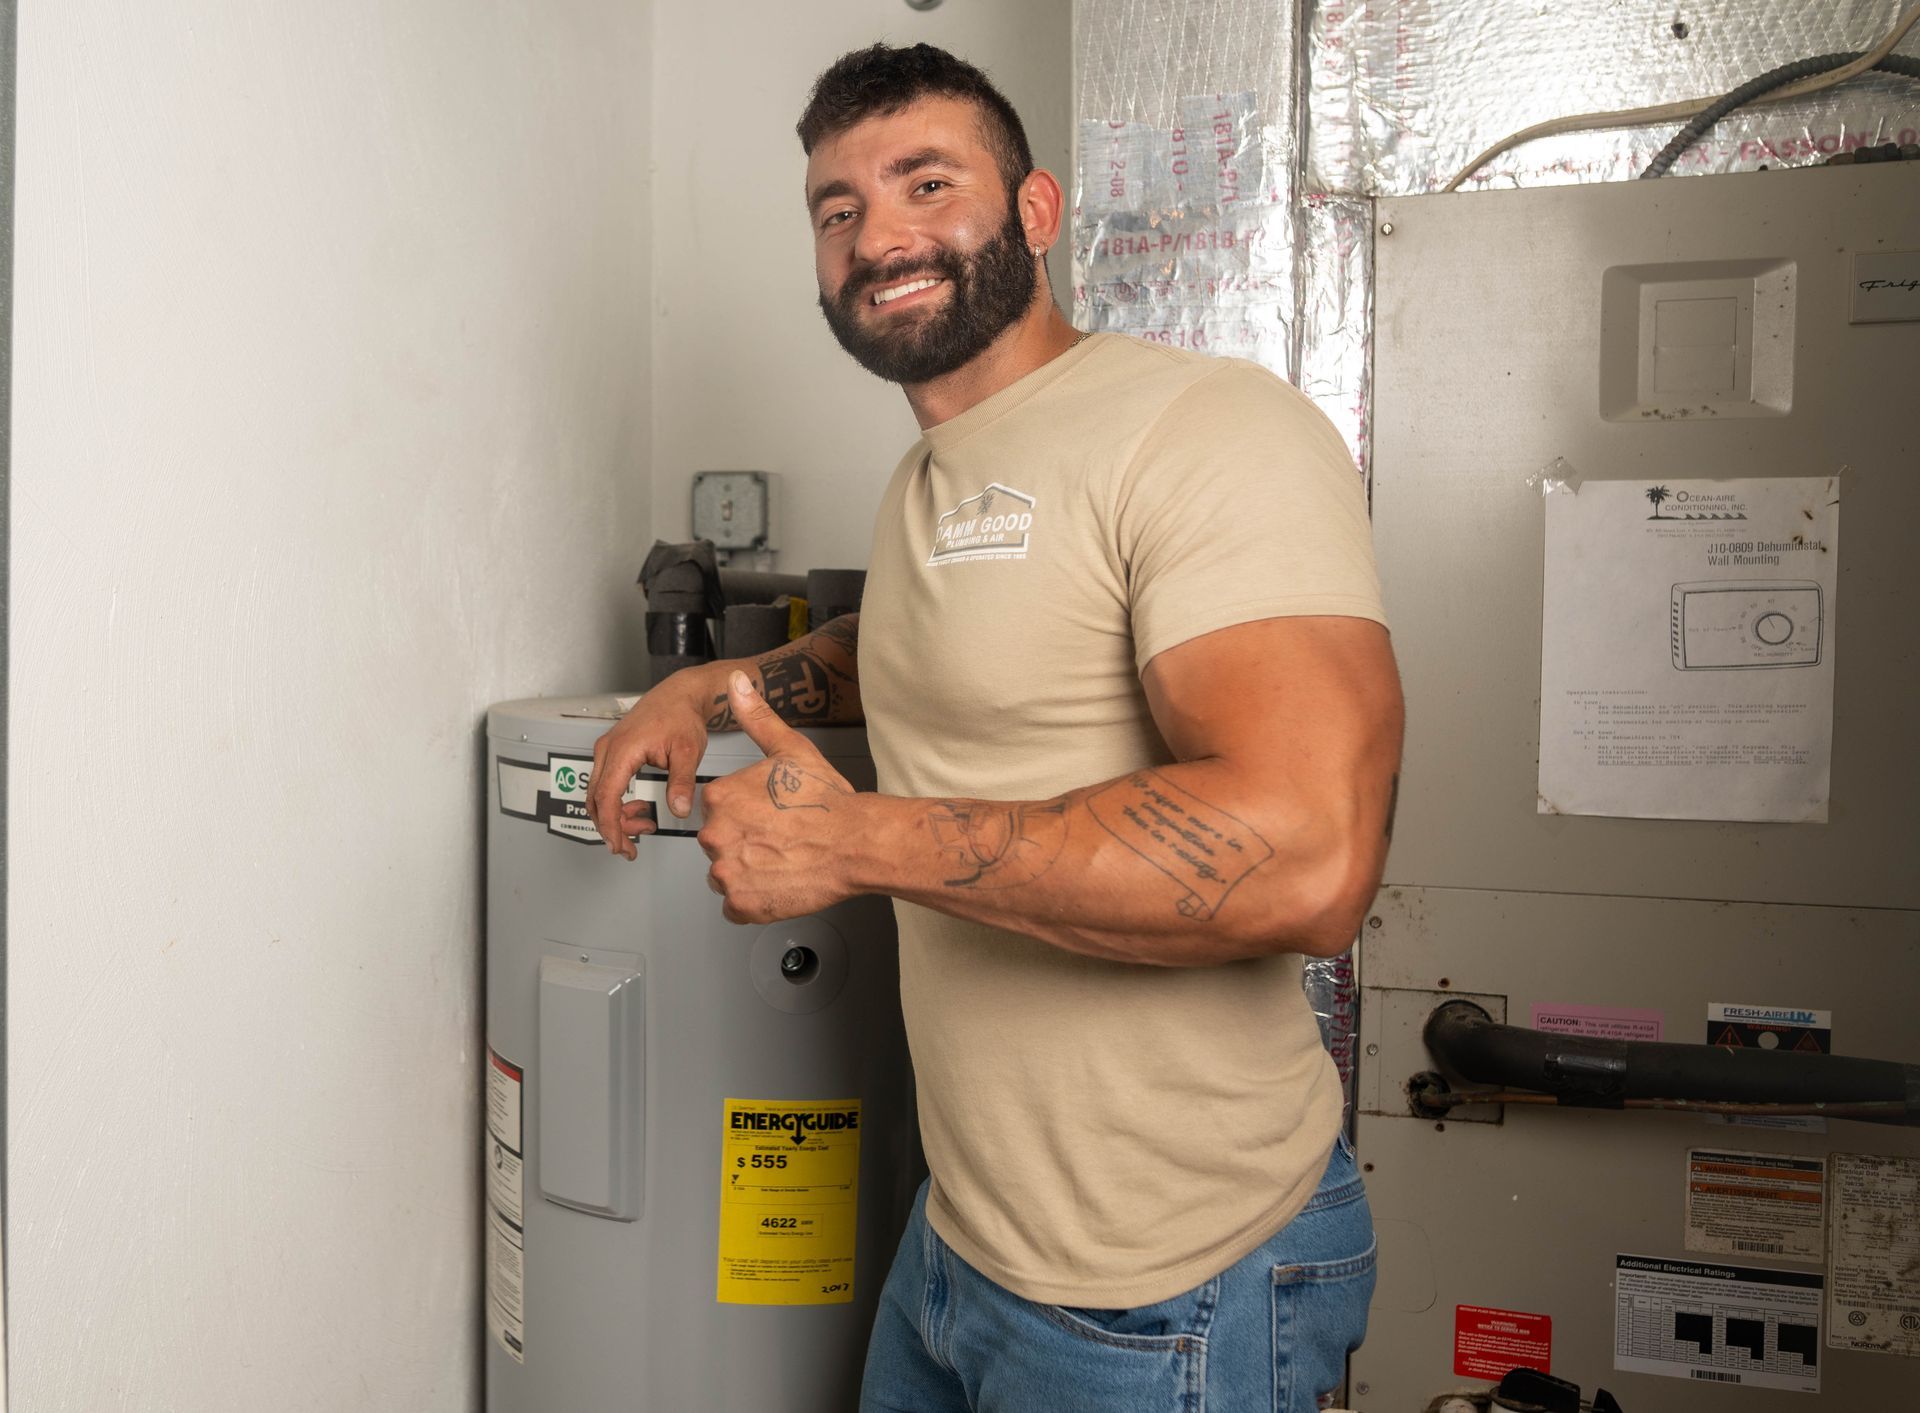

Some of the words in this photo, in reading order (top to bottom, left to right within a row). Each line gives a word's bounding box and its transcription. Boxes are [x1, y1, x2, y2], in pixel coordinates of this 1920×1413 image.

[1676, 490, 1736, 503] OCEAN-AIRE
[1665, 504, 1729, 513] CONDITIONING,
[1731, 504, 1748, 512] INC.
[980, 512, 1032, 533] GOOD
[990, 533, 1005, 542] AIR
[1707, 555, 1729, 567] Wall
[1733, 554, 1780, 567] Mounting
[1540, 1016, 1582, 1027] CAUTION:
[730, 1111, 859, 1132] ENERGYGUIDE
[737, 1157, 746, 1169] $
[751, 1154, 788, 1170] 555
[761, 1217, 797, 1229] 4622
[1620, 1259, 1663, 1272] Additional
[1664, 1263, 1702, 1275] Electrical
[1704, 1268, 1736, 1280] Ratings
